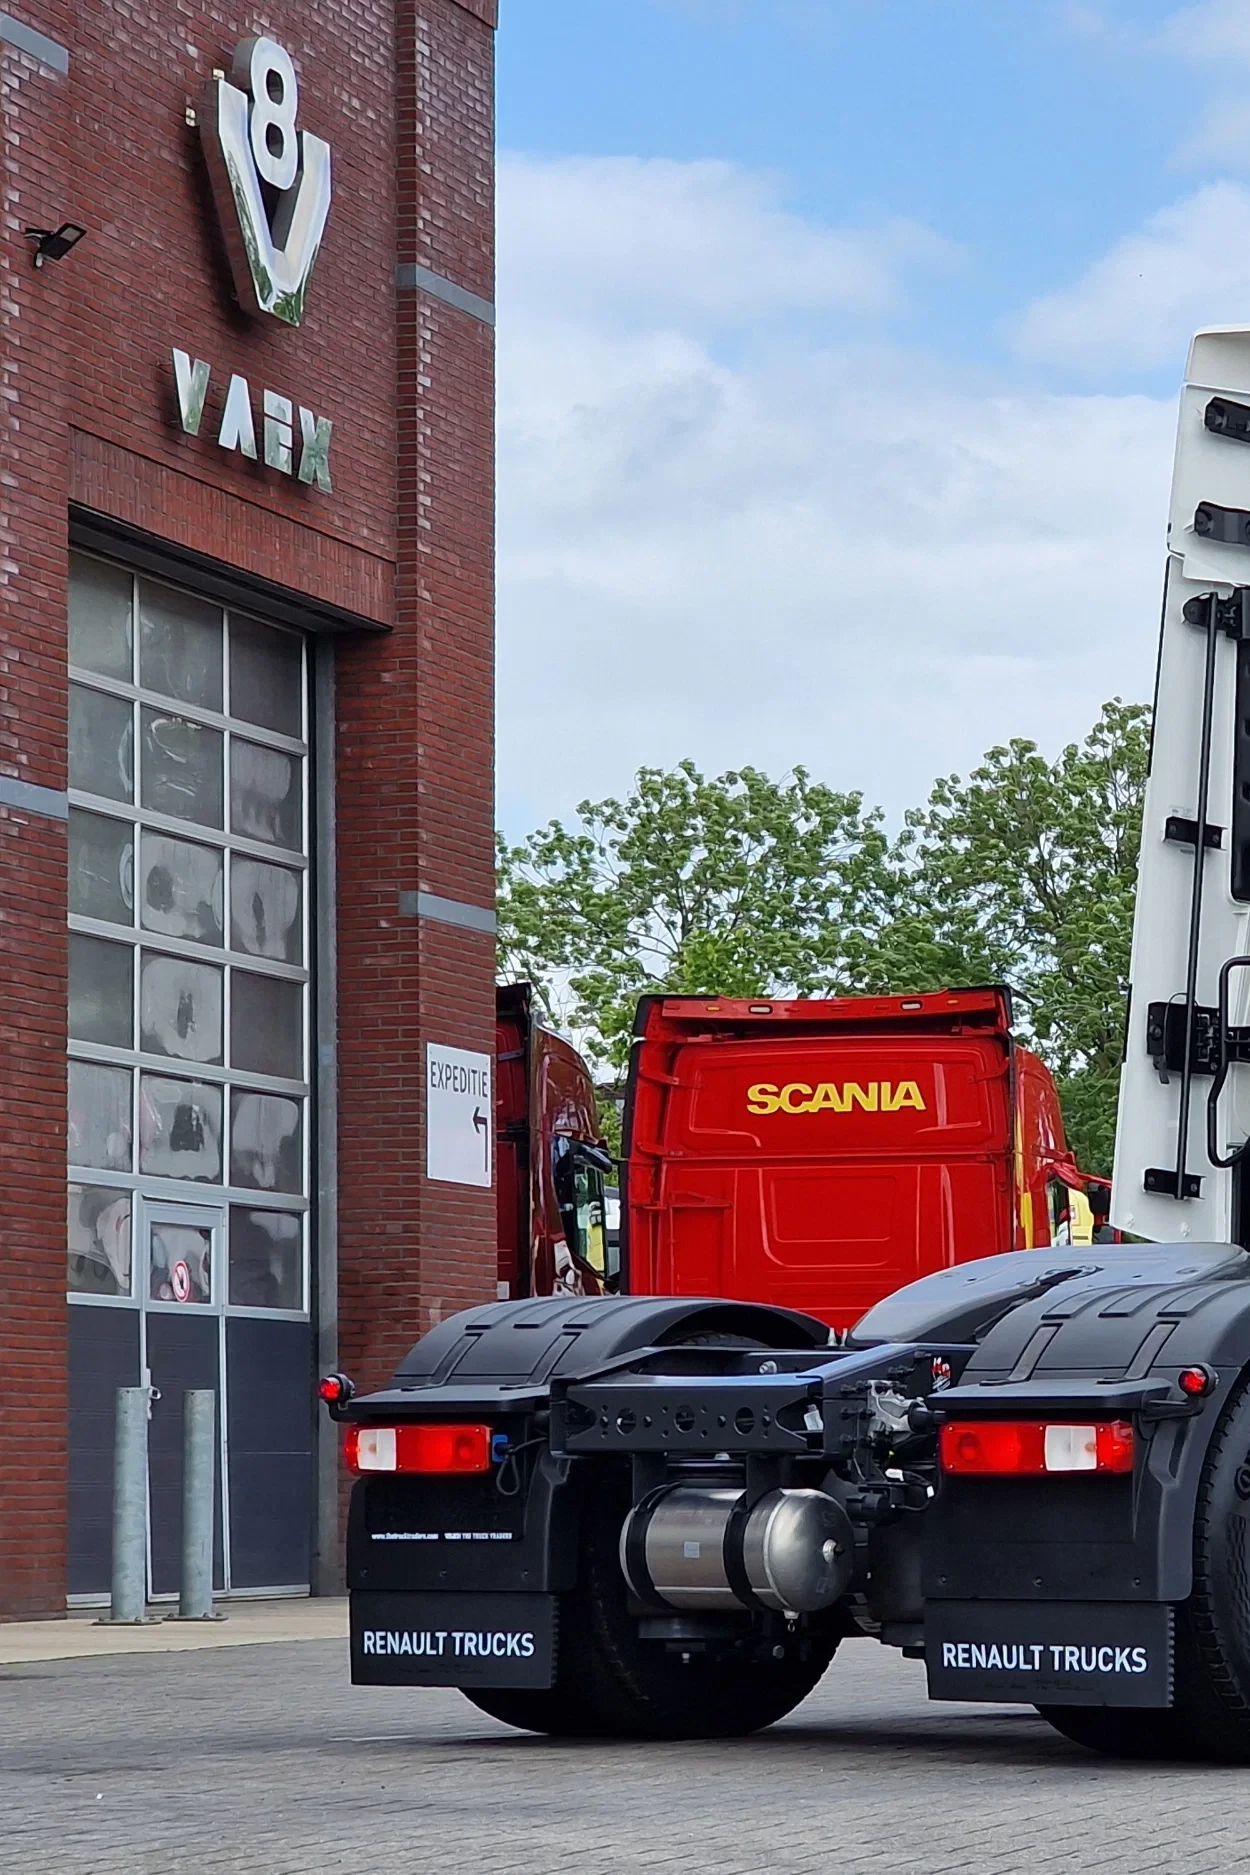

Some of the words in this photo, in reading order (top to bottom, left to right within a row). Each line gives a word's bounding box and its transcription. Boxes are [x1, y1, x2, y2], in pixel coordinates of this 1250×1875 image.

[171, 347, 334, 494] VAEX
[430, 1060, 489, 1098] EXPEDITIE
[746, 1081, 927, 1115] SCANIA
[363, 1630, 448, 1656] RENAULT
[451, 1631, 535, 1658] TRUCKS
[942, 1642, 1044, 1671] RENAULT
[1049, 1645, 1148, 1674] TRUCKS
